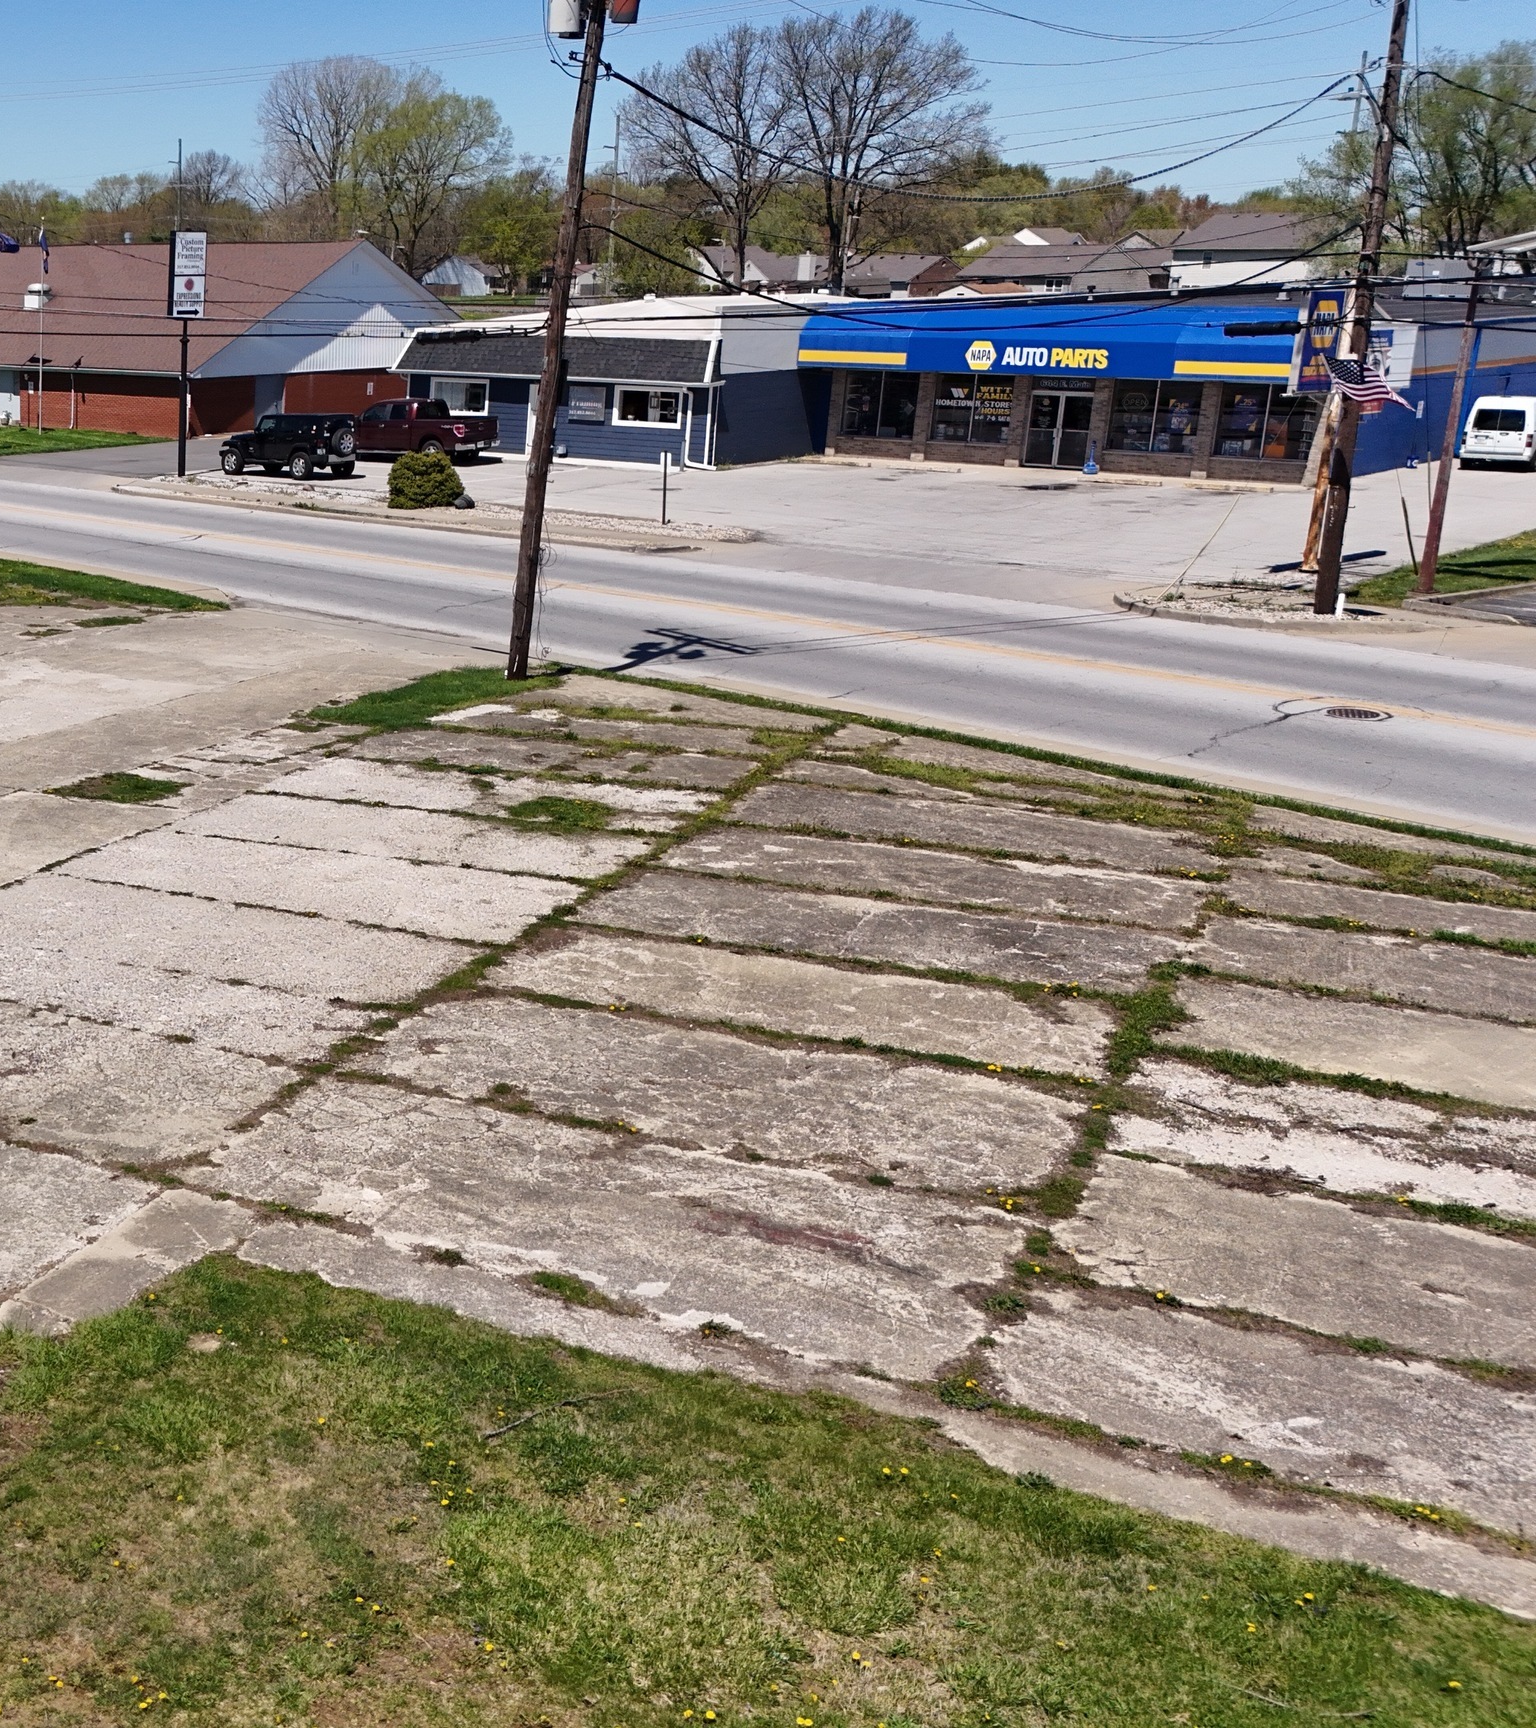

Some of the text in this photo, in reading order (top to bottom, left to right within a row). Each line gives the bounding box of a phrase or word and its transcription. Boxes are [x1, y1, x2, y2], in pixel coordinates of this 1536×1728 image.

[180, 238, 204, 246] Custom
[177, 252, 204, 261] Framing
[970, 347, 1109, 369] NAPA AUTO PARTS
[936, 398, 981, 407] HOMETOWN
